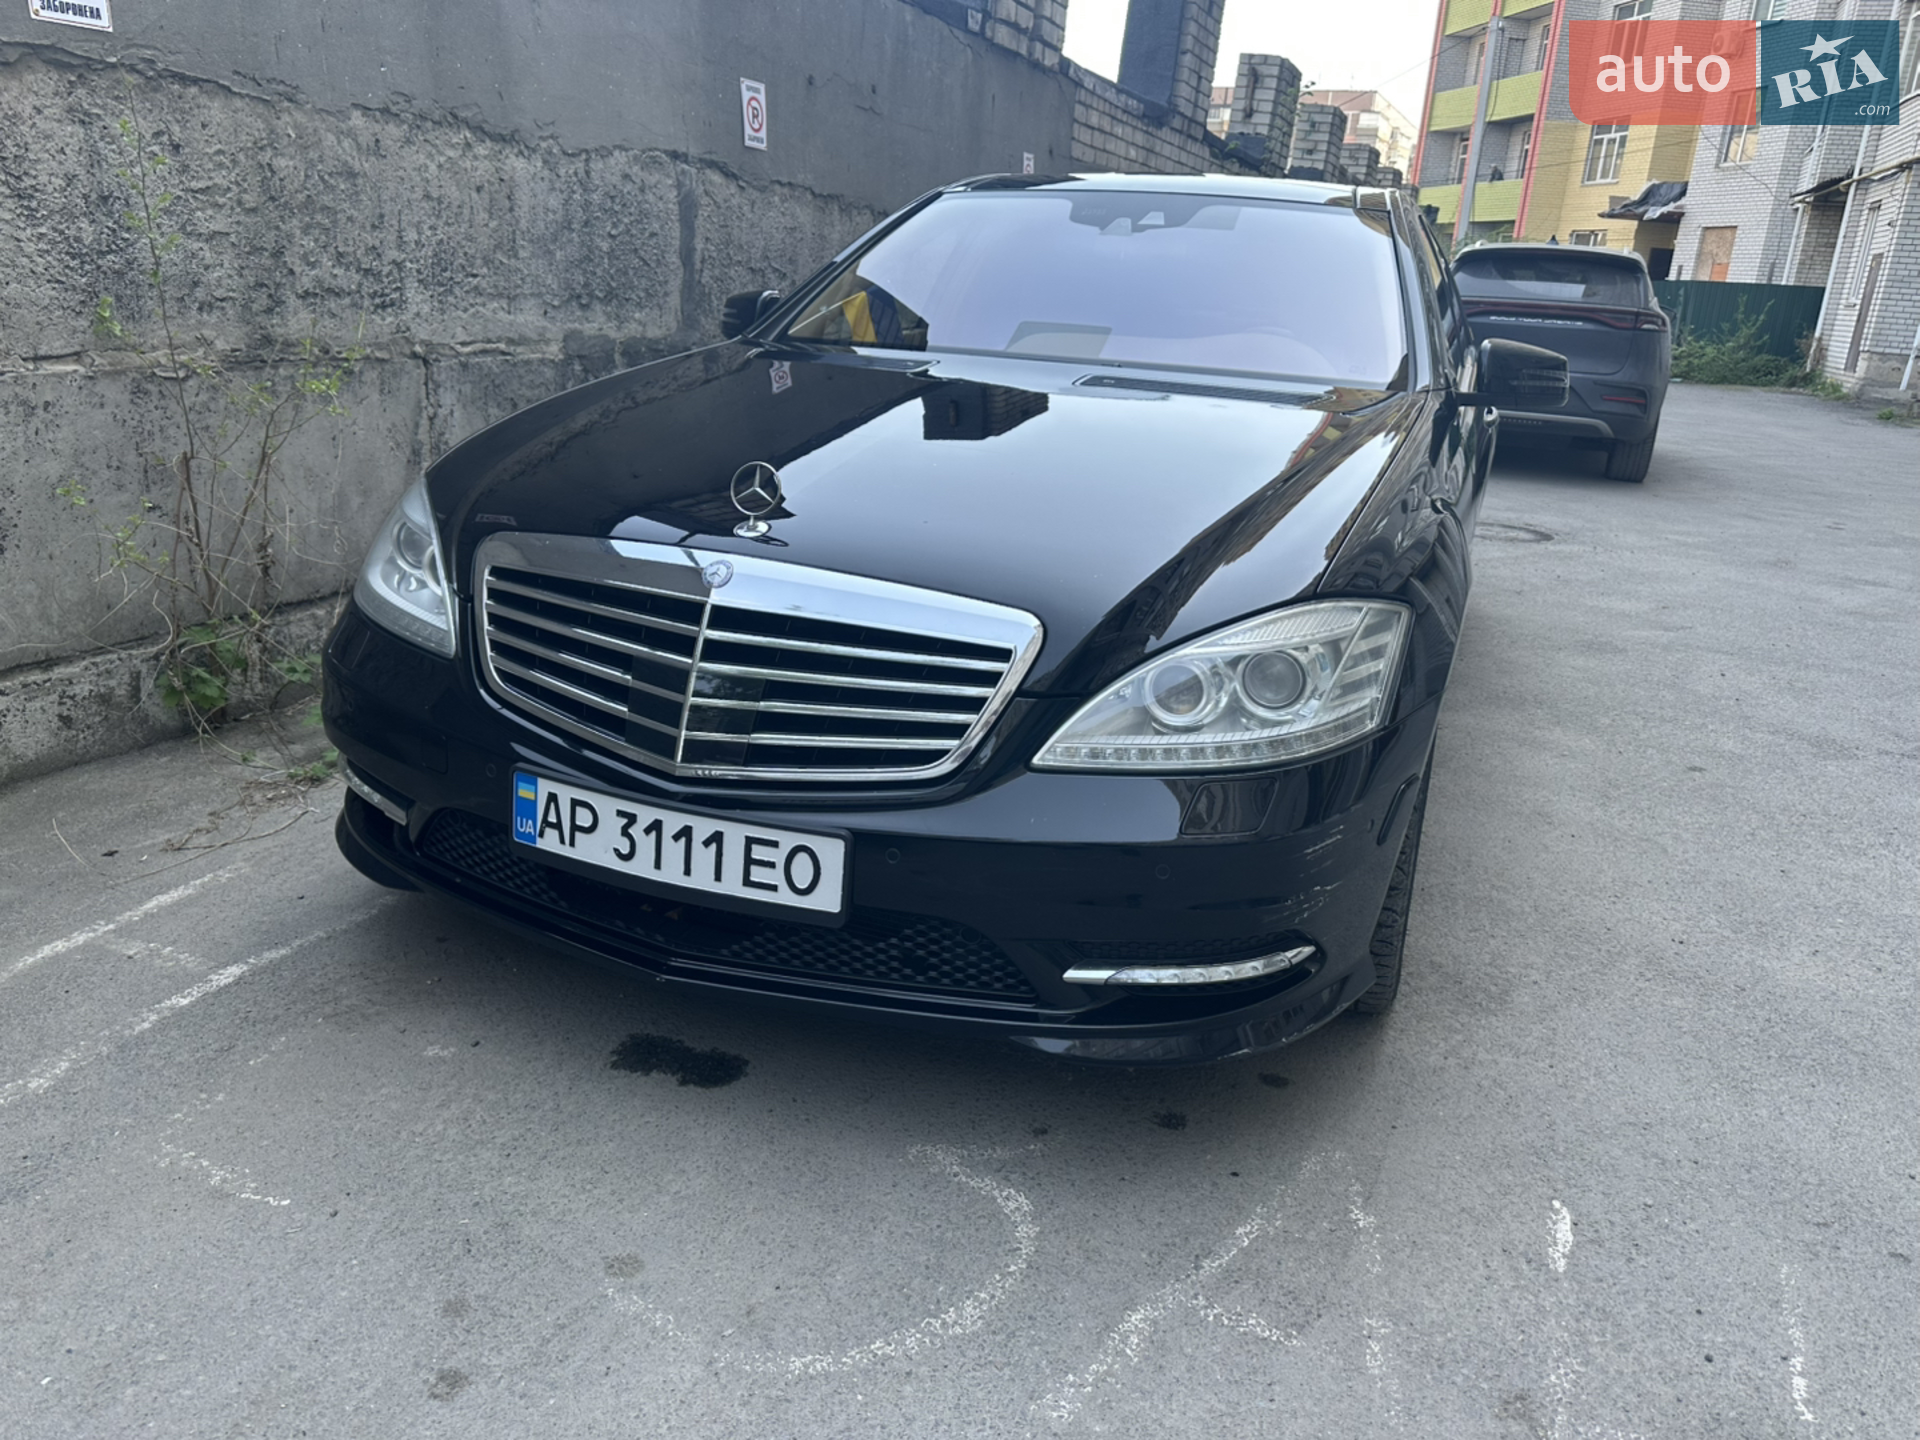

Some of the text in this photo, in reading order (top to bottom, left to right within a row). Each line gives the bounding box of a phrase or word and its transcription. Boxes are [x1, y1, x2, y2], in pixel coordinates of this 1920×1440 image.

[39, 0, 102, 20] ЗАБОРОНЕНА
[516, 816, 535, 836] UA
[537, 790, 822, 896] AP 3111 EO
